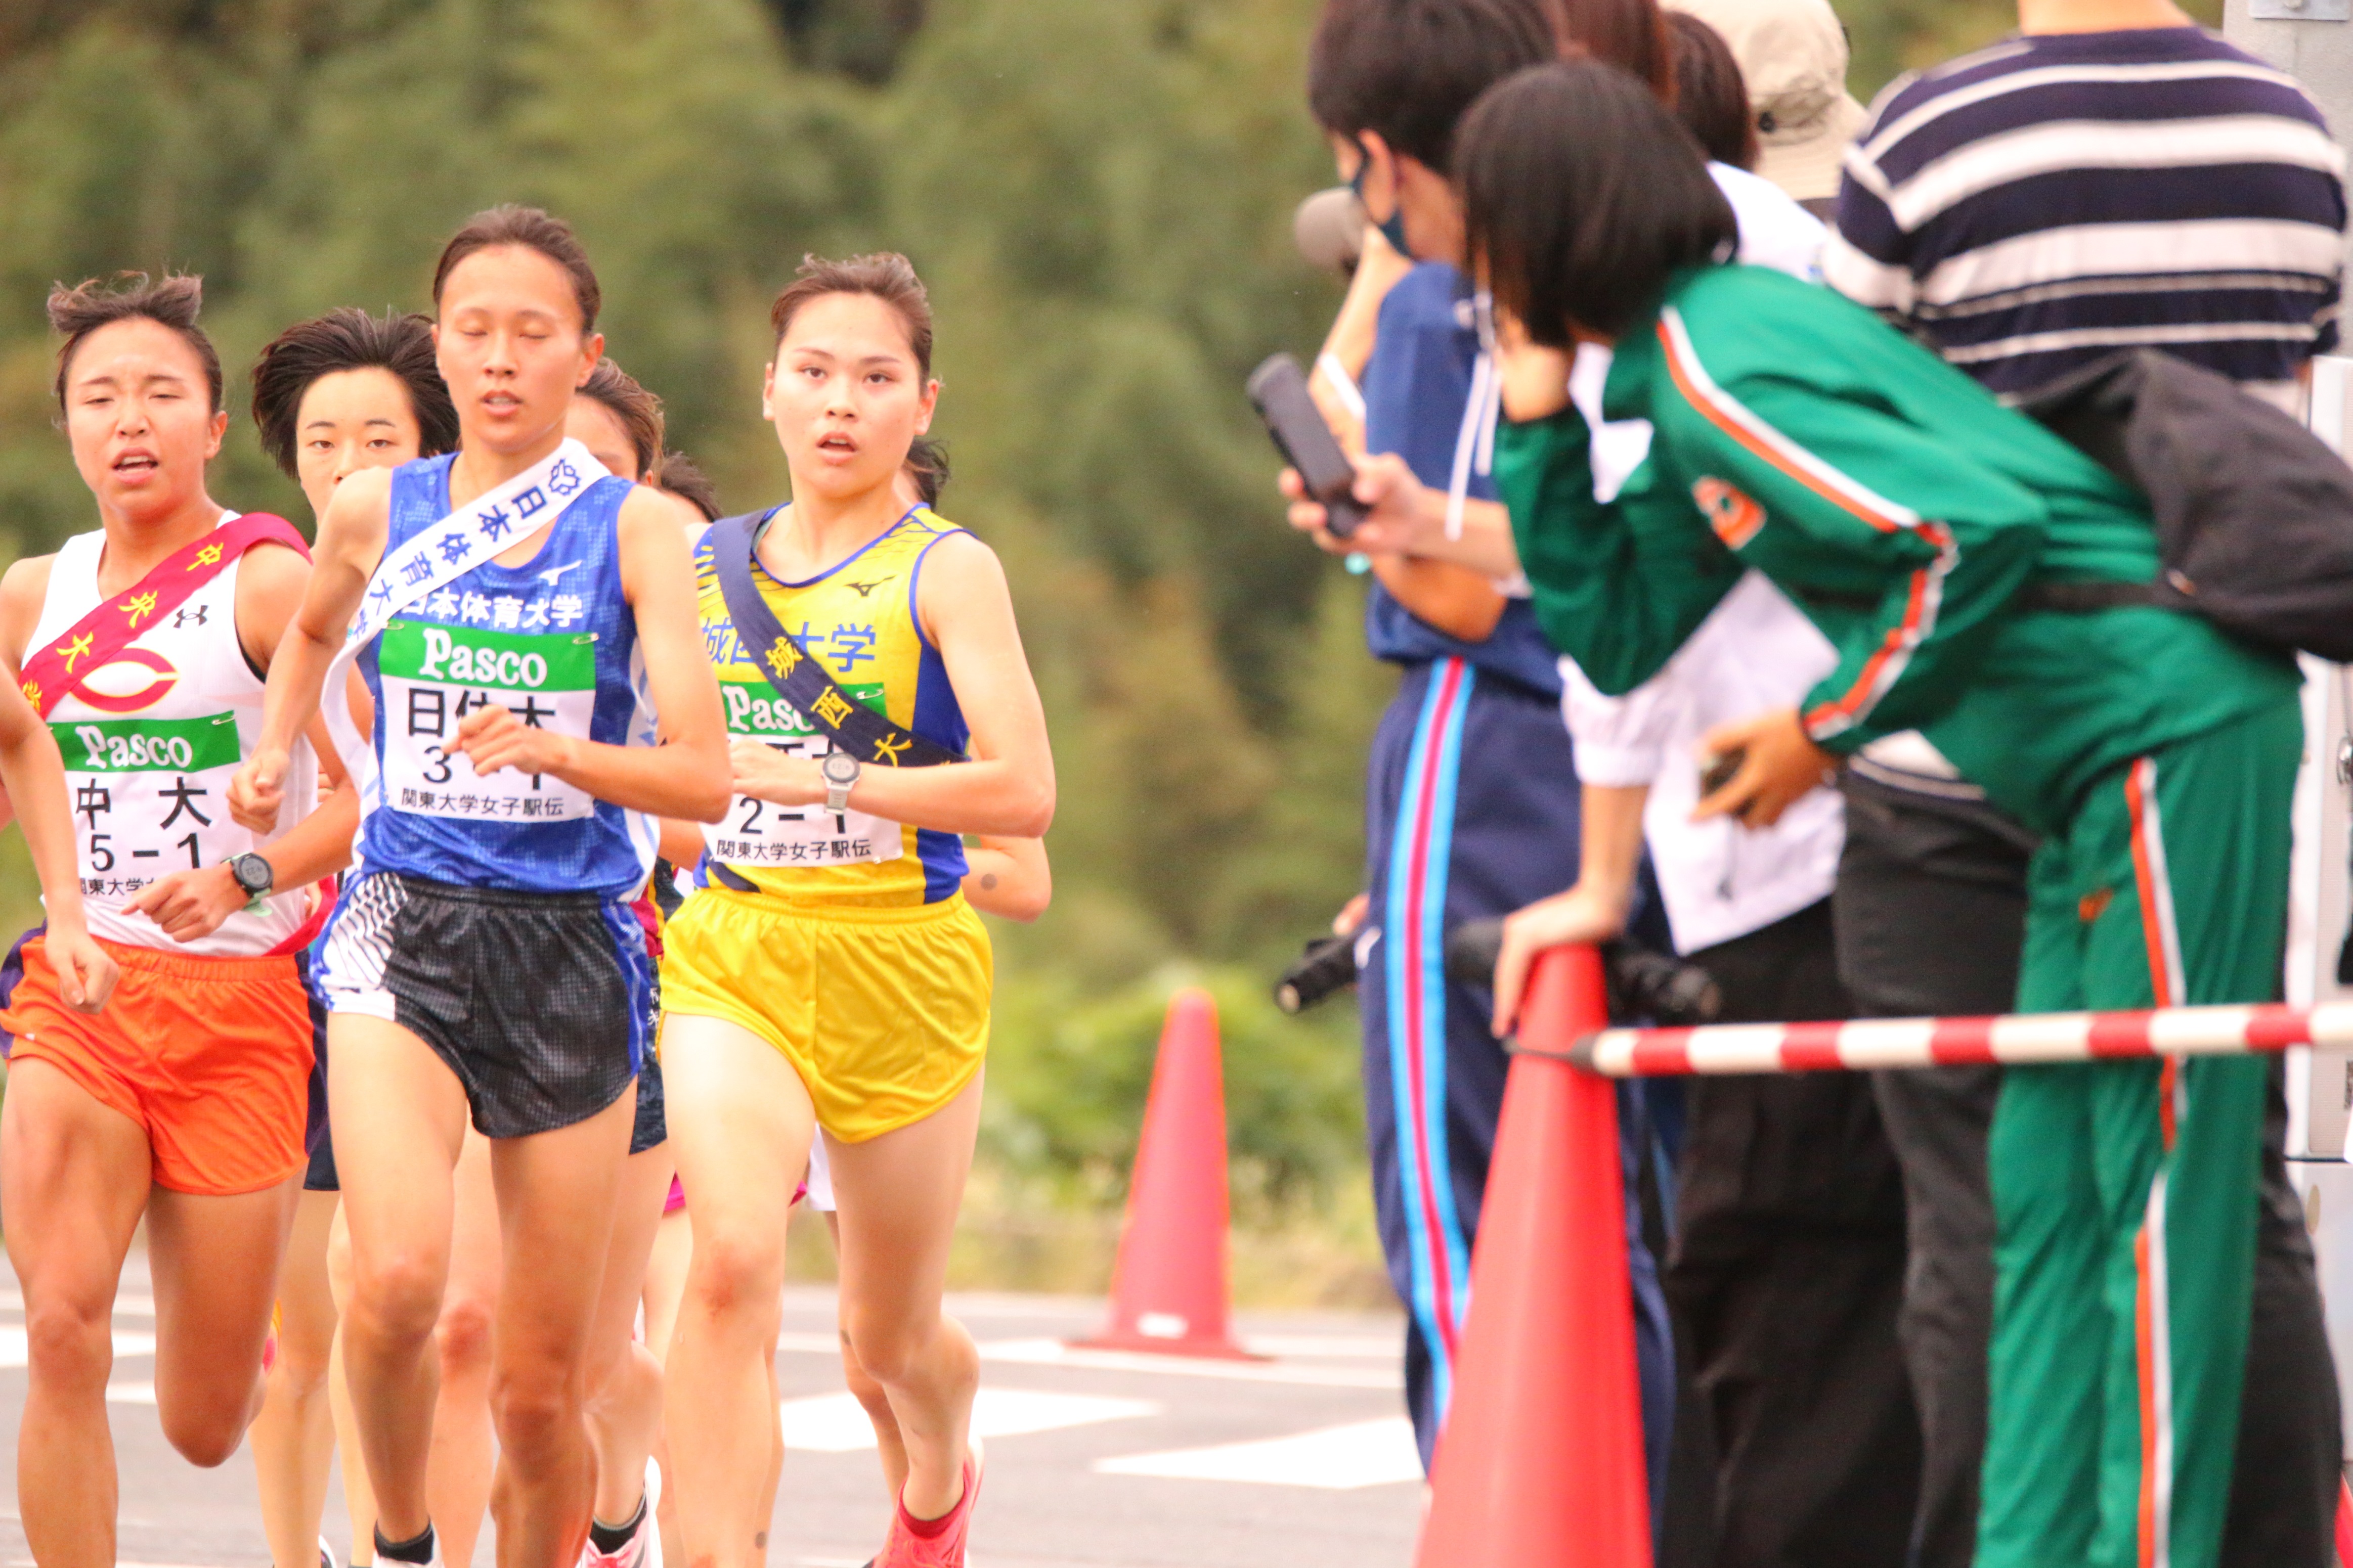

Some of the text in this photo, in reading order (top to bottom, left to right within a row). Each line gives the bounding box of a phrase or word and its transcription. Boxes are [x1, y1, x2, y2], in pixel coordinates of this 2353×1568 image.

[419, 628, 548, 688] Pasco
[75, 725, 193, 770] Pasco
[401, 787, 564, 817] 関東大学女子駅伝
[717, 838, 872, 861] 関東大学女子駅伝
